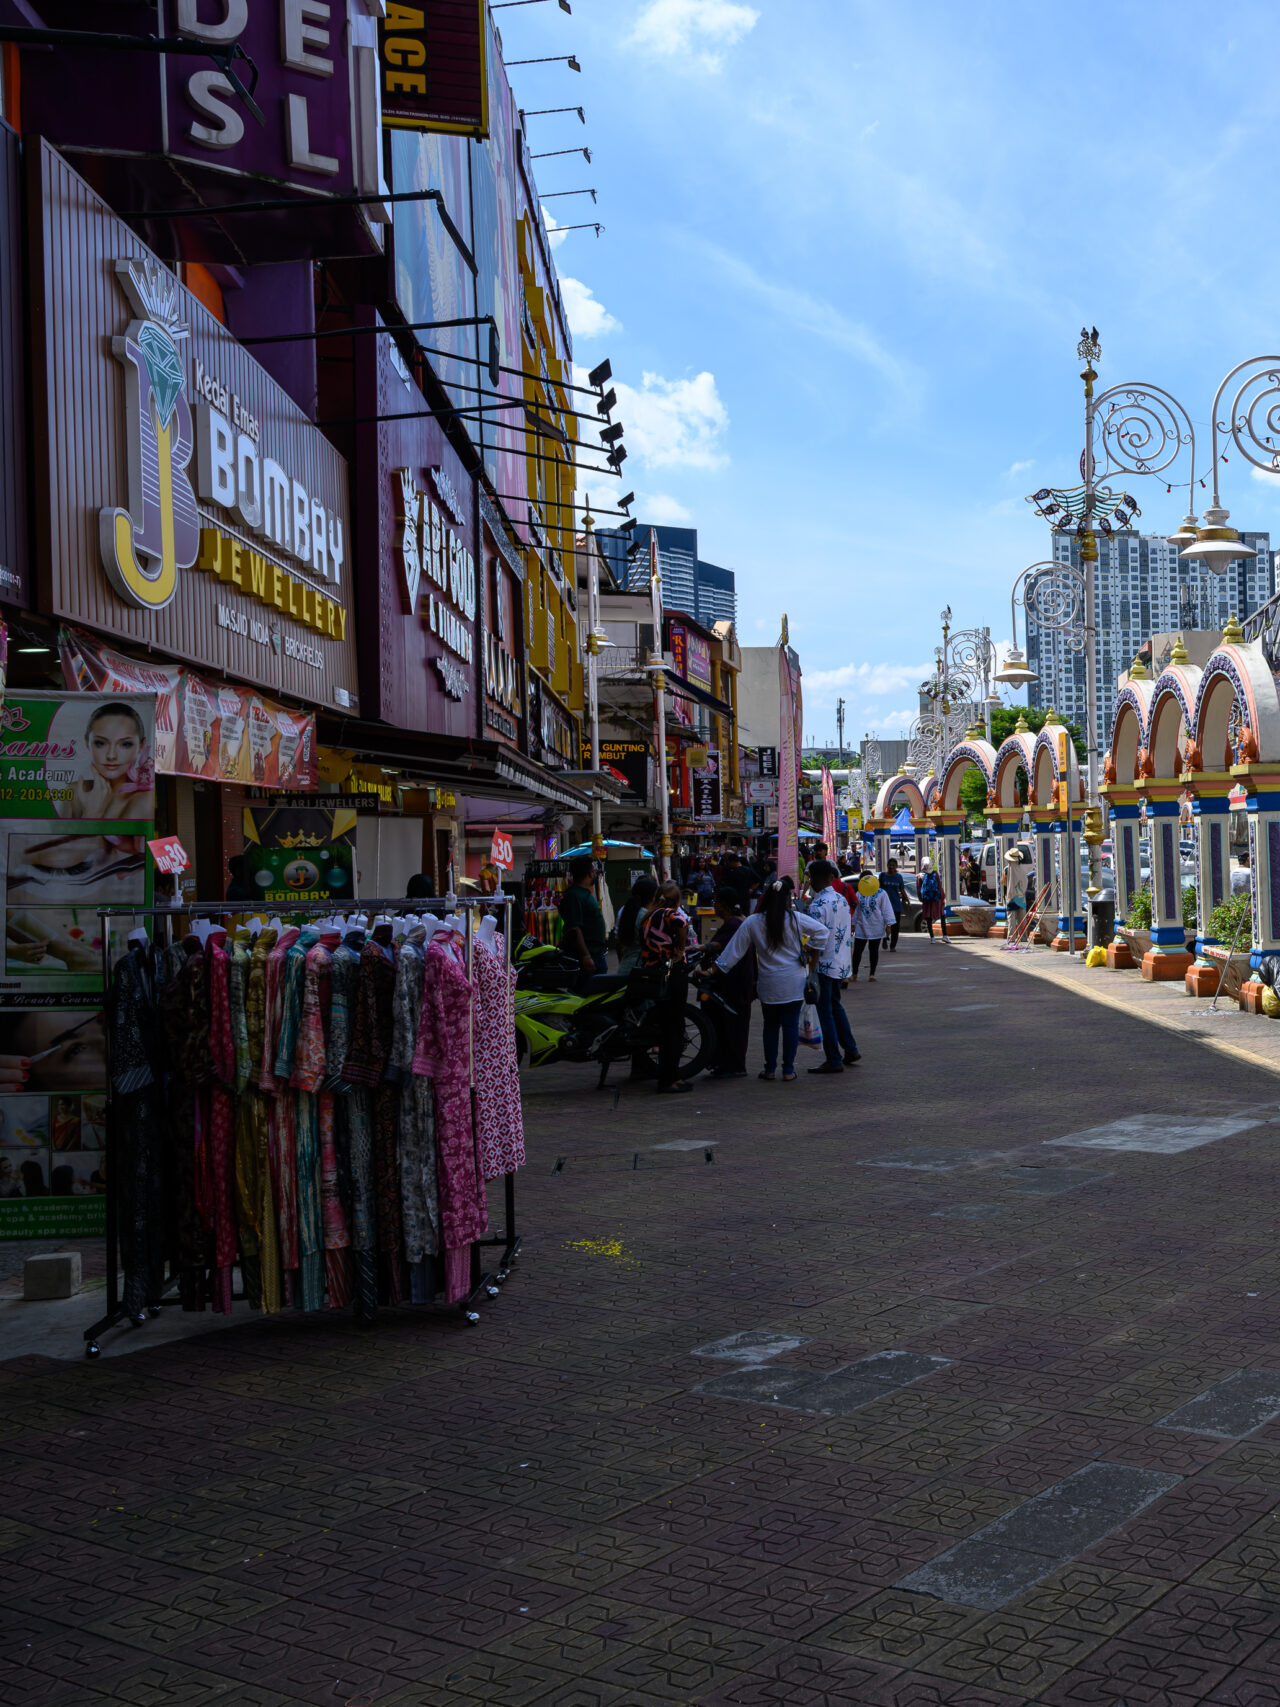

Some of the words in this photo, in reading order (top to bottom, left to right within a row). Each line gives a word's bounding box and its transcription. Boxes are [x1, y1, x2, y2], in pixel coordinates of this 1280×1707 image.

[196, 359, 229, 416] Kedai
[232, 392, 260, 441] Emas
[206, 404, 344, 587] BOMBAY
[201, 528, 347, 641] JEWELLERY
[448, 528, 475, 622] GOLD
[218, 602, 248, 637] MASJID
[250, 611, 271, 646] INDIA
[285, 634, 324, 670] BRICKFIELDS
[584, 751, 626, 760] RMBUT
[602, 743, 645, 752] GUNTING
[7, 766, 75, 784] Academy
[762, 748, 773, 775] JEEL
[316, 798, 376, 808] JEWELLERS
[699, 778, 713, 815] TAILORS
[264, 890, 331, 901] BOMBAY
[37, 1227, 56, 1236] spa
[59, 1227, 105, 1235] academy
